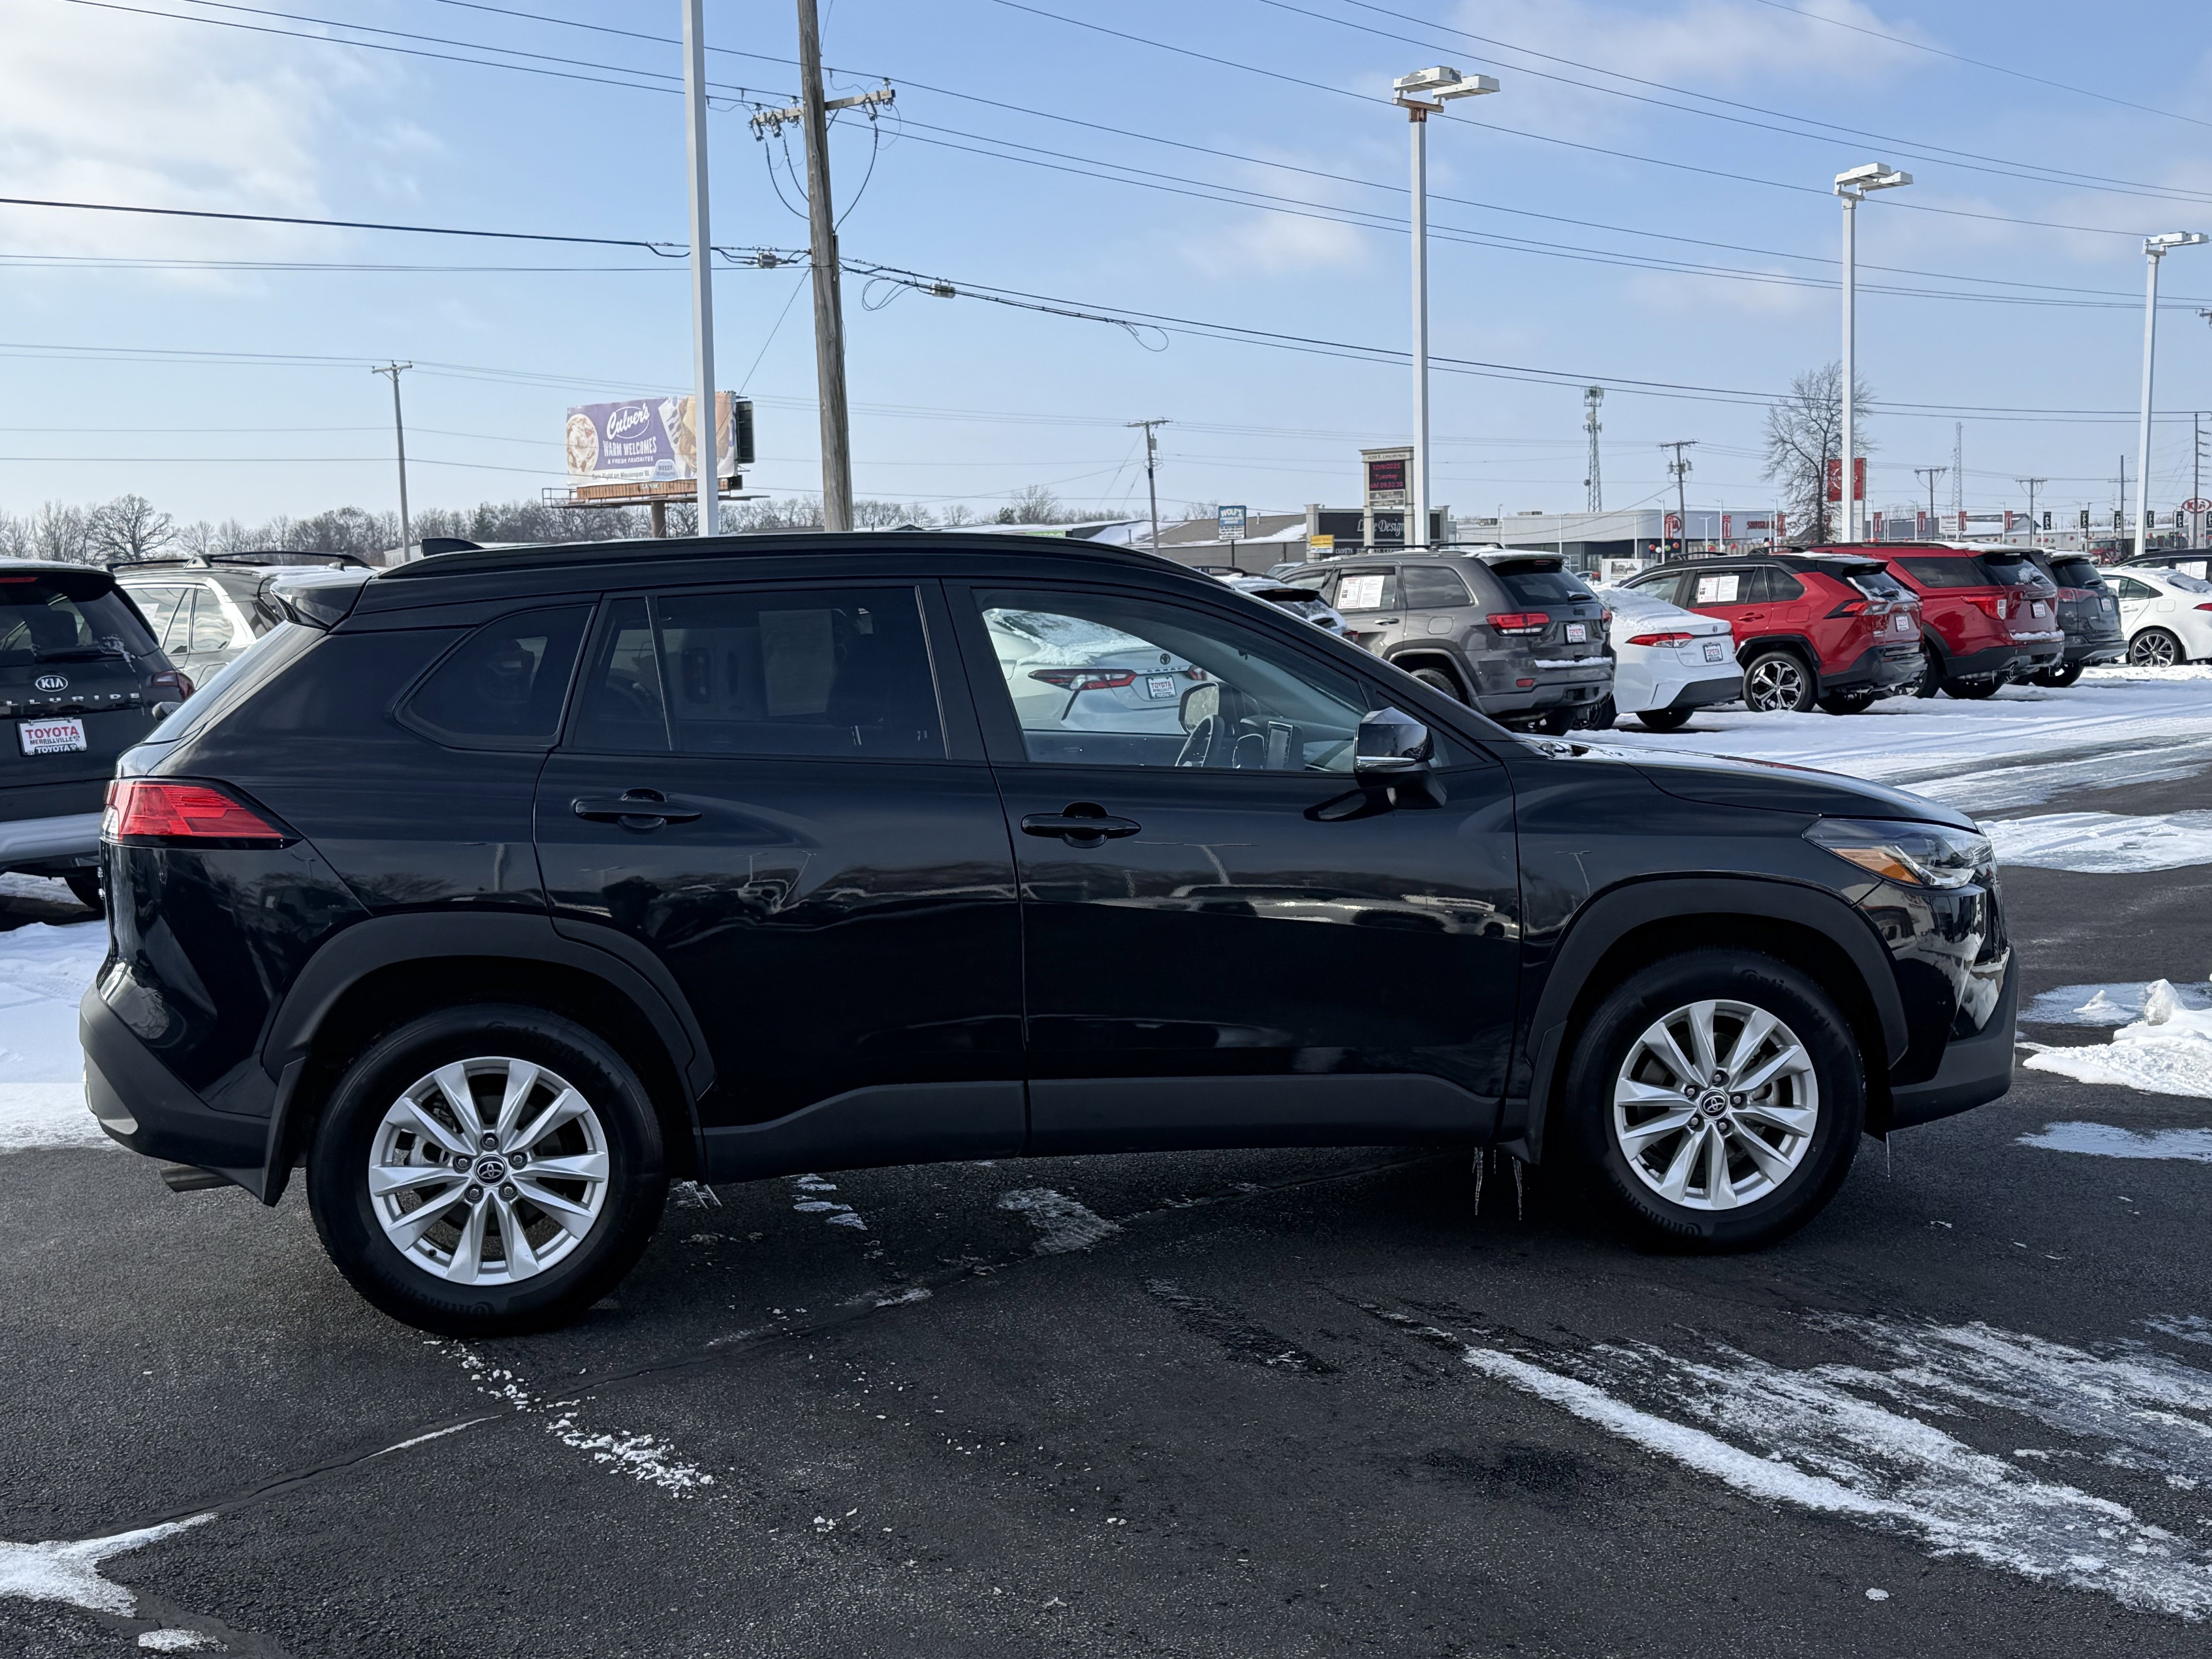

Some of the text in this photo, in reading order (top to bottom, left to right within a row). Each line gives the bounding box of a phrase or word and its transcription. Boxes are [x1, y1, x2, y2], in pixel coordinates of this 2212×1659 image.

[606, 403, 650, 440] Culver's
[603, 436, 657, 457] WARM WELCOMES
[2187, 501, 2205, 510] KA
[40, 678, 64, 689] KIA
[25, 725, 79, 739] TOYOTA
[30, 737, 73, 745] MERRILLVILLE
[36, 745, 70, 754] TOYOTA
